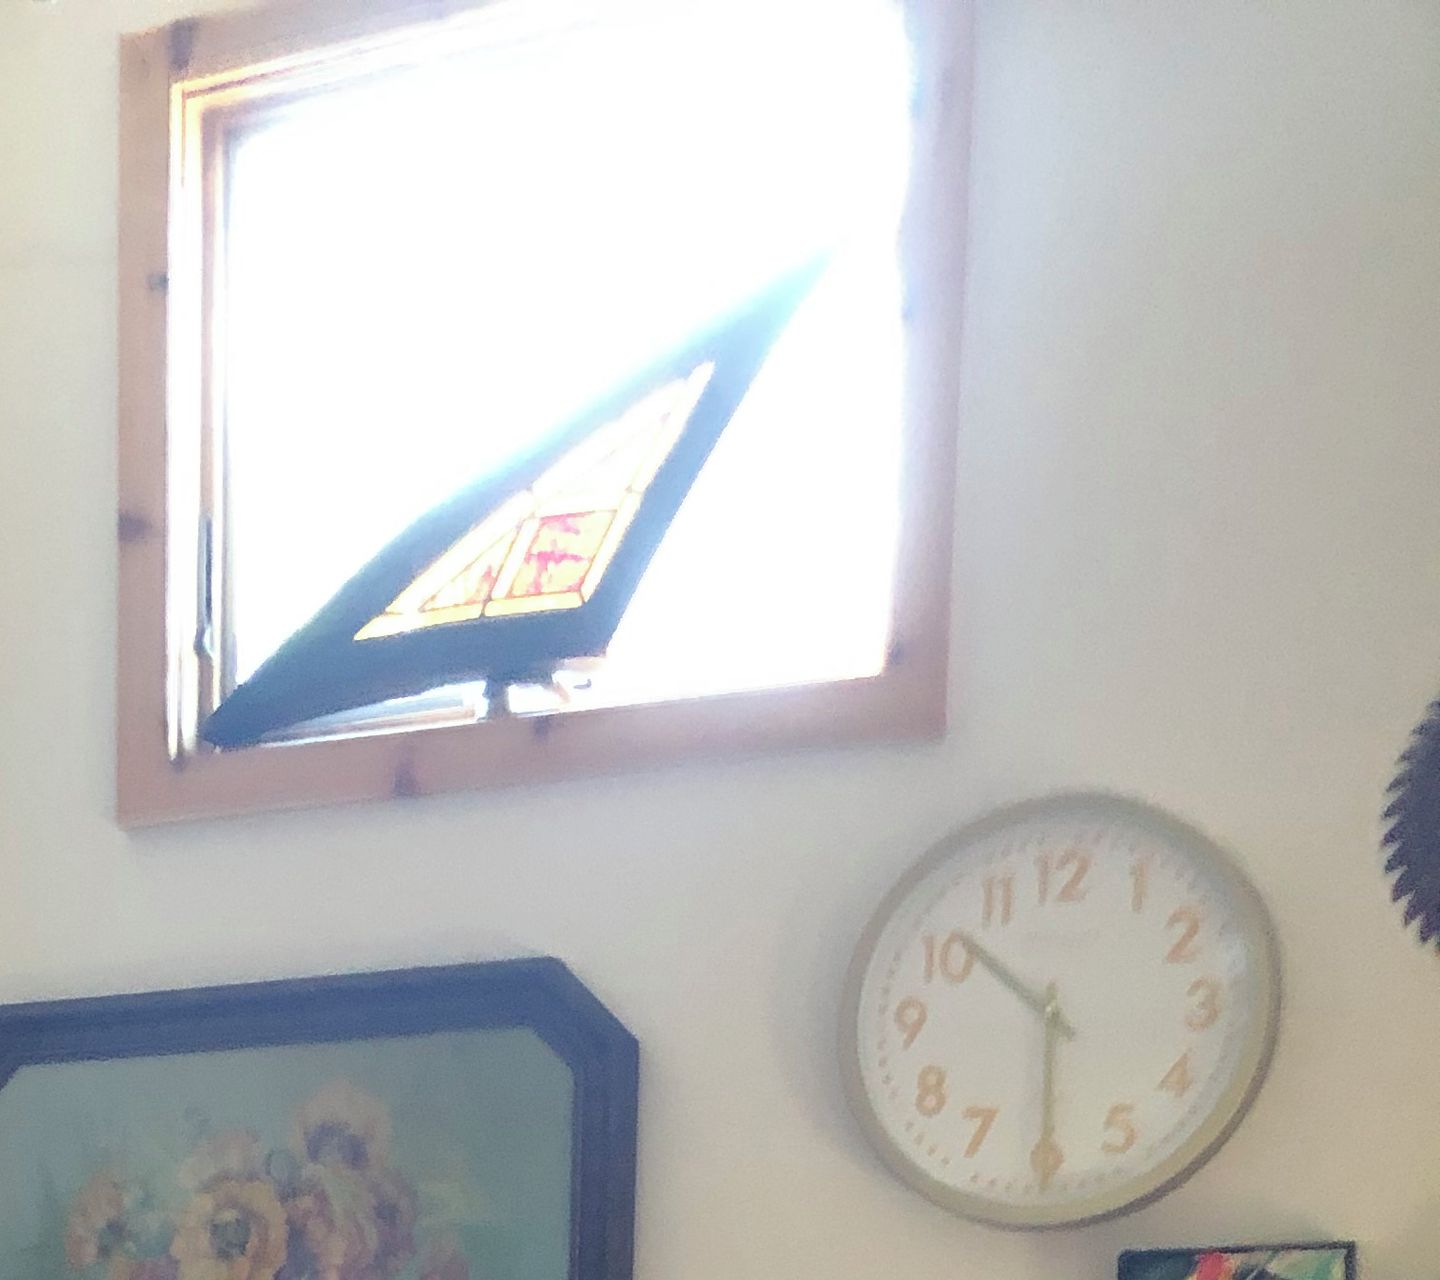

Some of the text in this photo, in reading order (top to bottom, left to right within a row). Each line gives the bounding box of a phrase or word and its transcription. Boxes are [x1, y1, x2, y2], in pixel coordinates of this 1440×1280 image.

[984, 876, 1014, 926] 11
[1036, 848, 1090, 904] 12
[1131, 862, 1151, 911] 1
[922, 932, 976, 983] 10
[1165, 907, 1201, 962] 2
[895, 996, 927, 1049] 9
[1186, 978, 1222, 1031] 3
[915, 1065, 946, 1117] 8
[1159, 1048, 1192, 1098] 4
[962, 1107, 998, 1157] 7
[1102, 1104, 1136, 1154] 5
